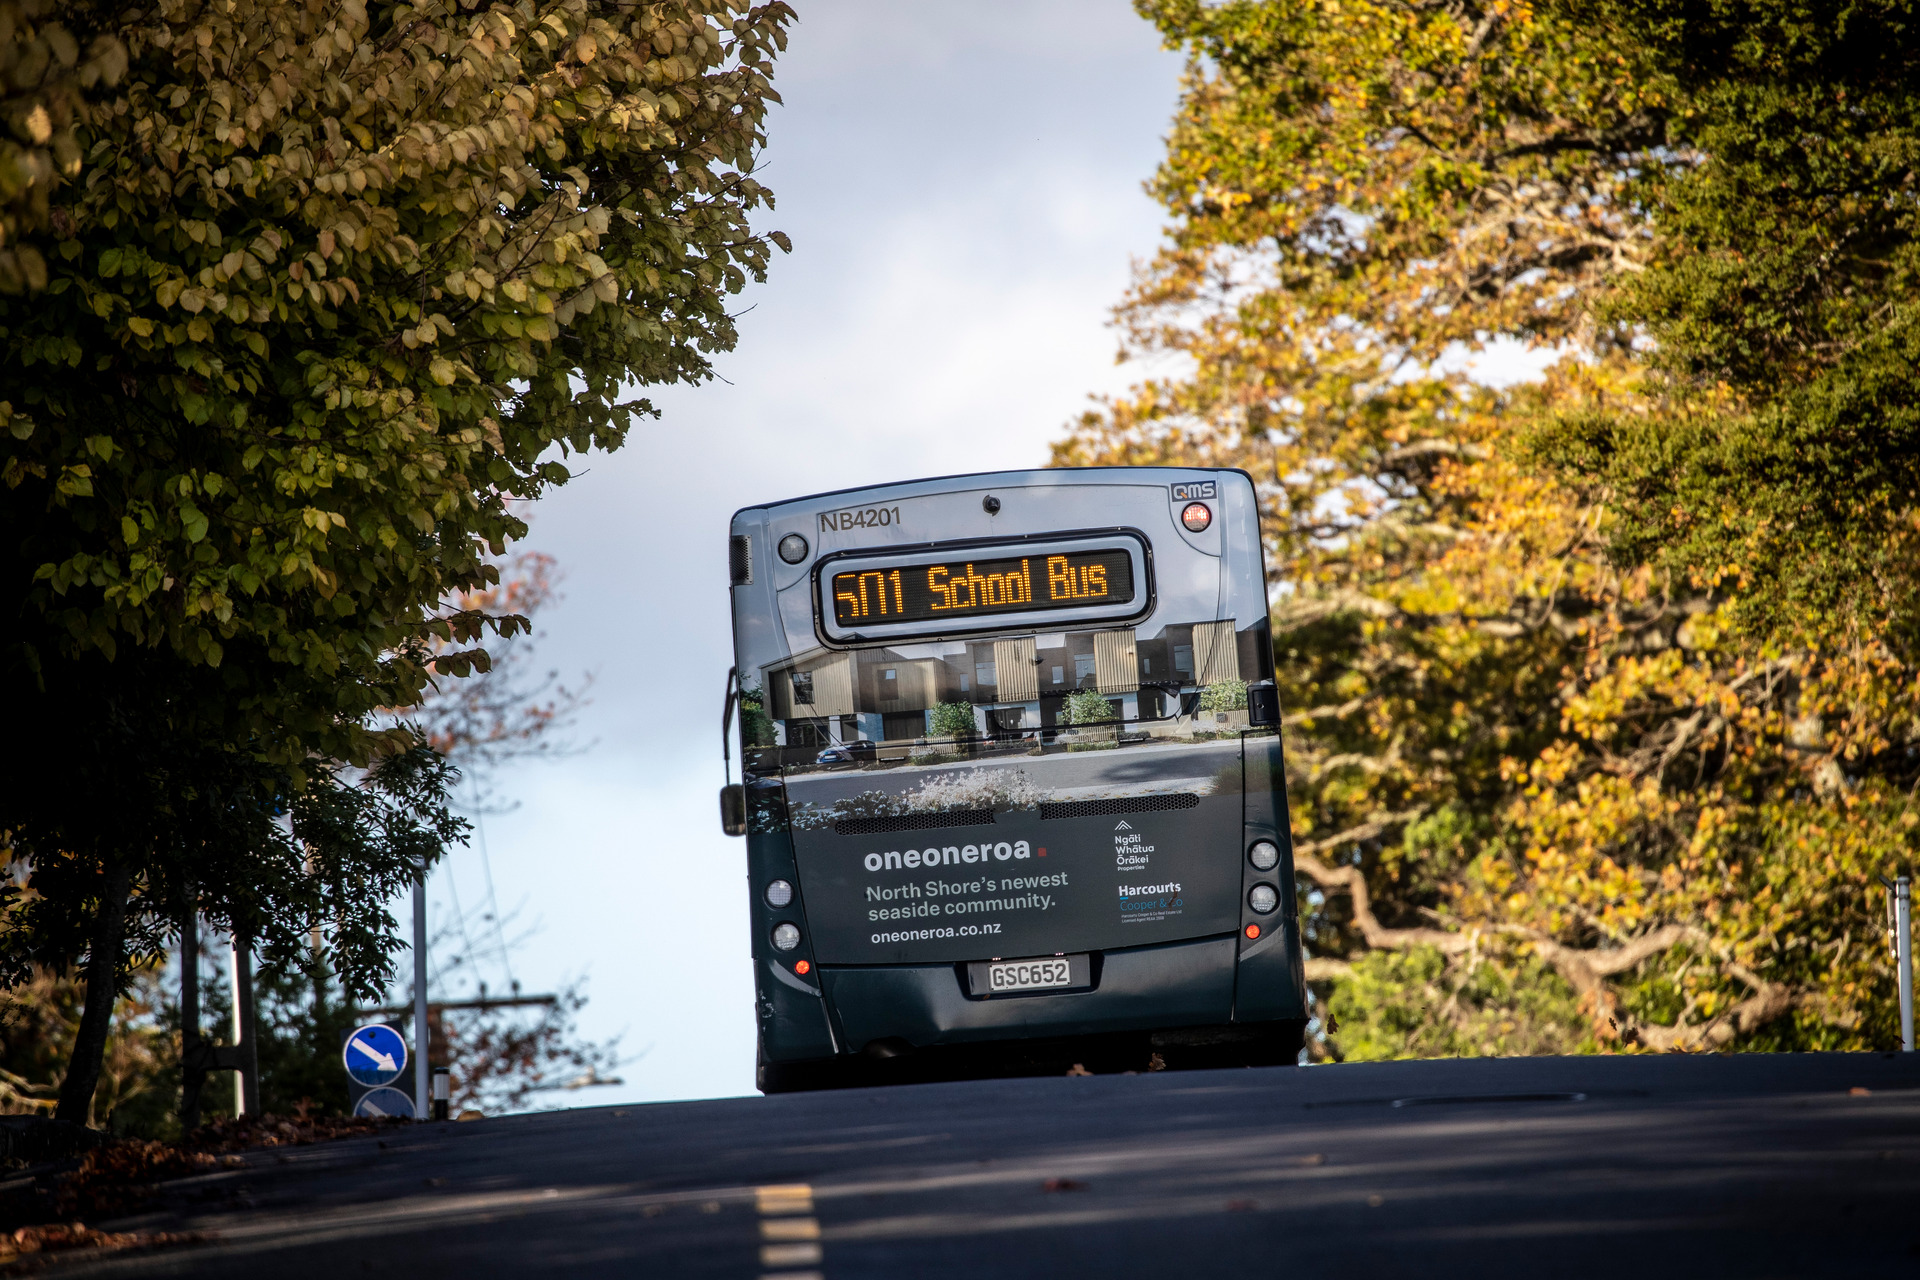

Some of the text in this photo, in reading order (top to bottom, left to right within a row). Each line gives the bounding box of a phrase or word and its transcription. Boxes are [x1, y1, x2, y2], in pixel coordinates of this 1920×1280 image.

[1173, 482, 1215, 500] QMS
[820, 507, 900, 532] NB4201
[928, 559, 1031, 609] School
[1047, 555, 1108, 600] Bus
[1114, 833, 1141, 846] Ngāti
[1115, 844, 1154, 854] Whātua
[864, 840, 1031, 872] oneoneroa
[1116, 854, 1149, 865] Ōrākei
[866, 882, 921, 902] North
[1001, 872, 1069, 891] newest
[1118, 882, 1181, 896] Harcourts
[868, 894, 1056, 921] seaside community.
[1120, 901, 1157, 911] Cooper
[871, 923, 1002, 944] oneoneroa.co.nz
[992, 963, 1067, 987] GSC652
